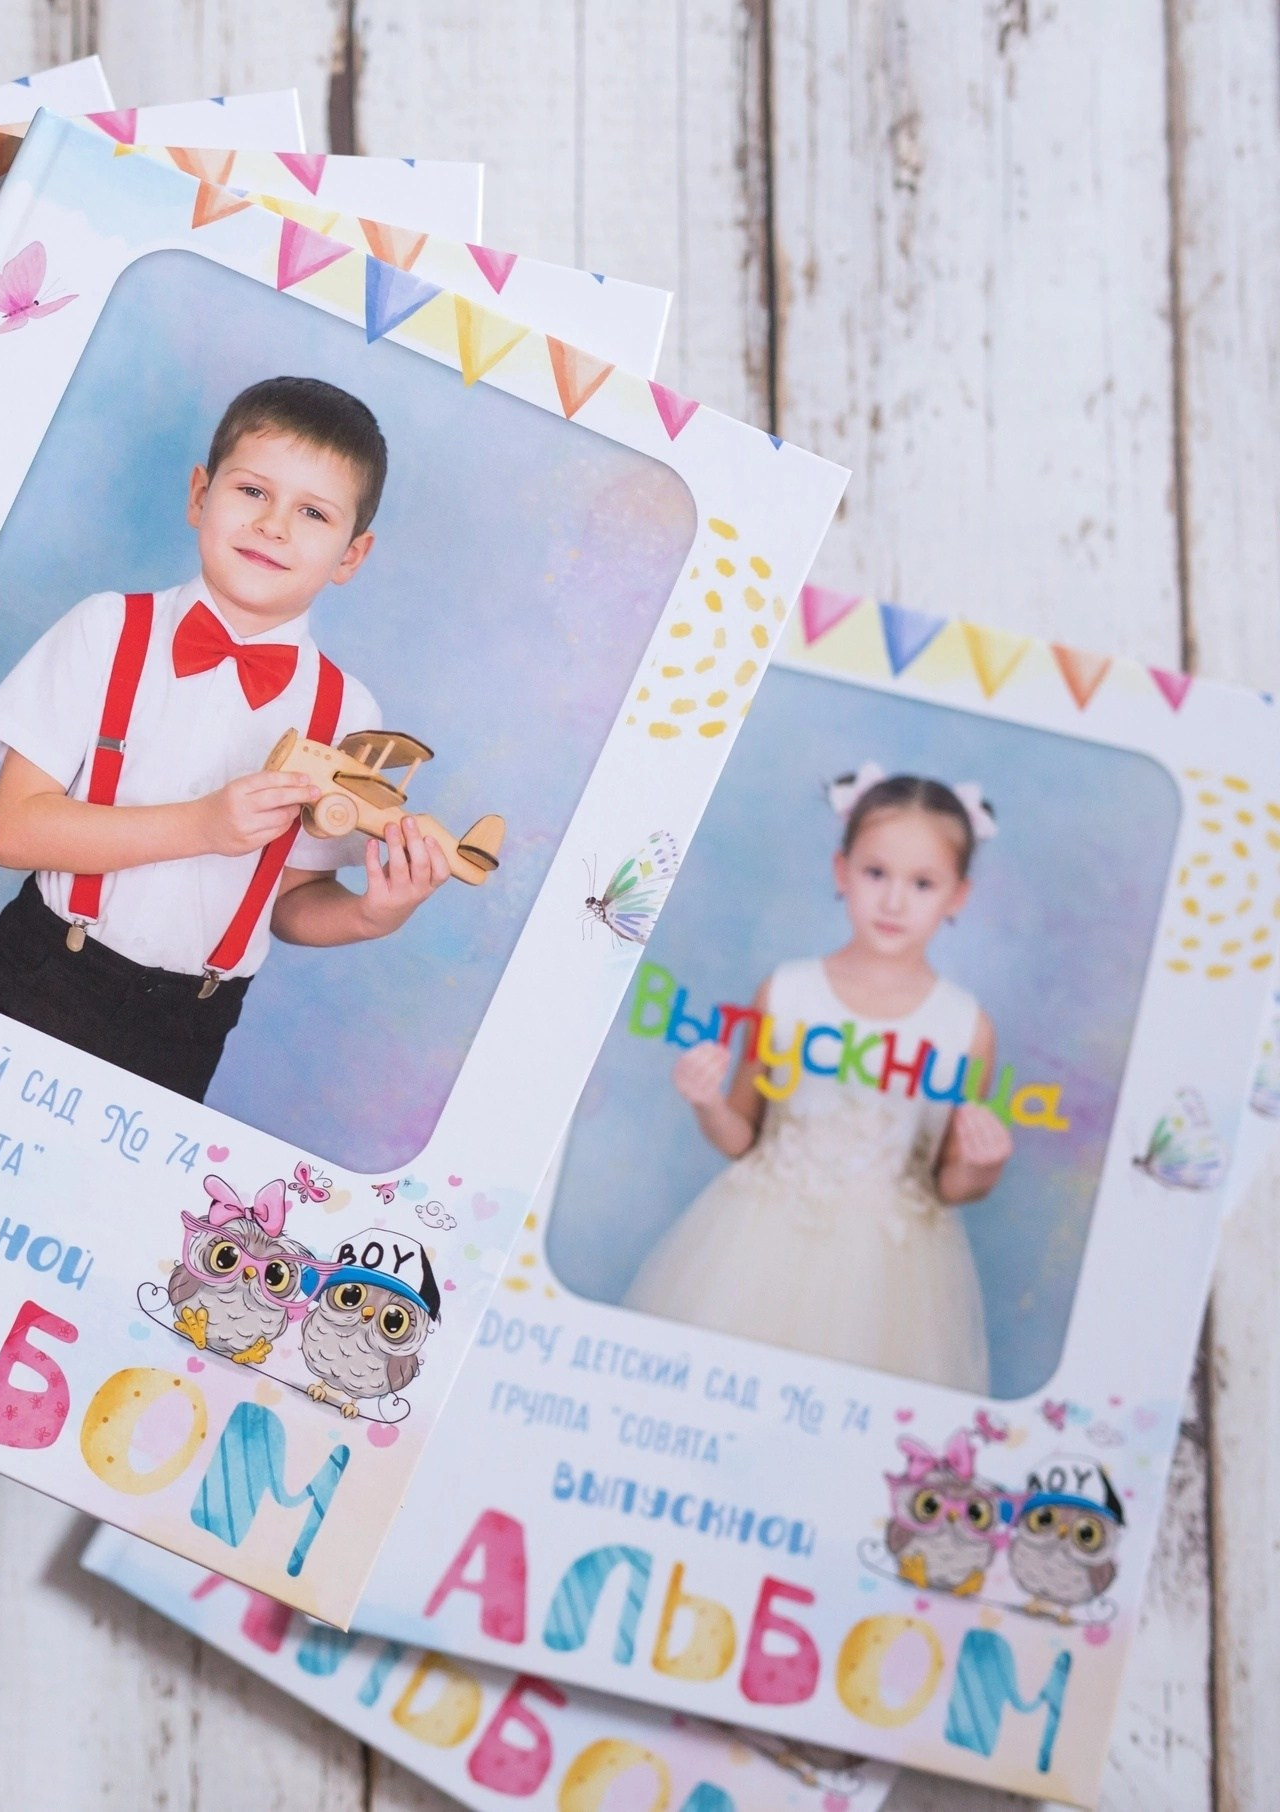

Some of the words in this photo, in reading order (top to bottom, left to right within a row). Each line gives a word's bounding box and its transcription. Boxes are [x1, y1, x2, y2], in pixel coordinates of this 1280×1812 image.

[21, 1070, 82, 1125] САД
[166, 1133, 201, 1174] 74
[337, 1242, 415, 1274] BOY
[489, 1381, 590, 1433] ГРУППА
[570, 1335, 690, 1391] ДЕТСКИЙ
[704, 1367, 761, 1411] САД
[841, 1397, 872, 1433] 74
[553, 1460, 817, 1557] ВЫПУСКНОЙ
[424, 1507, 1072, 1775] АЛЬБОМ
